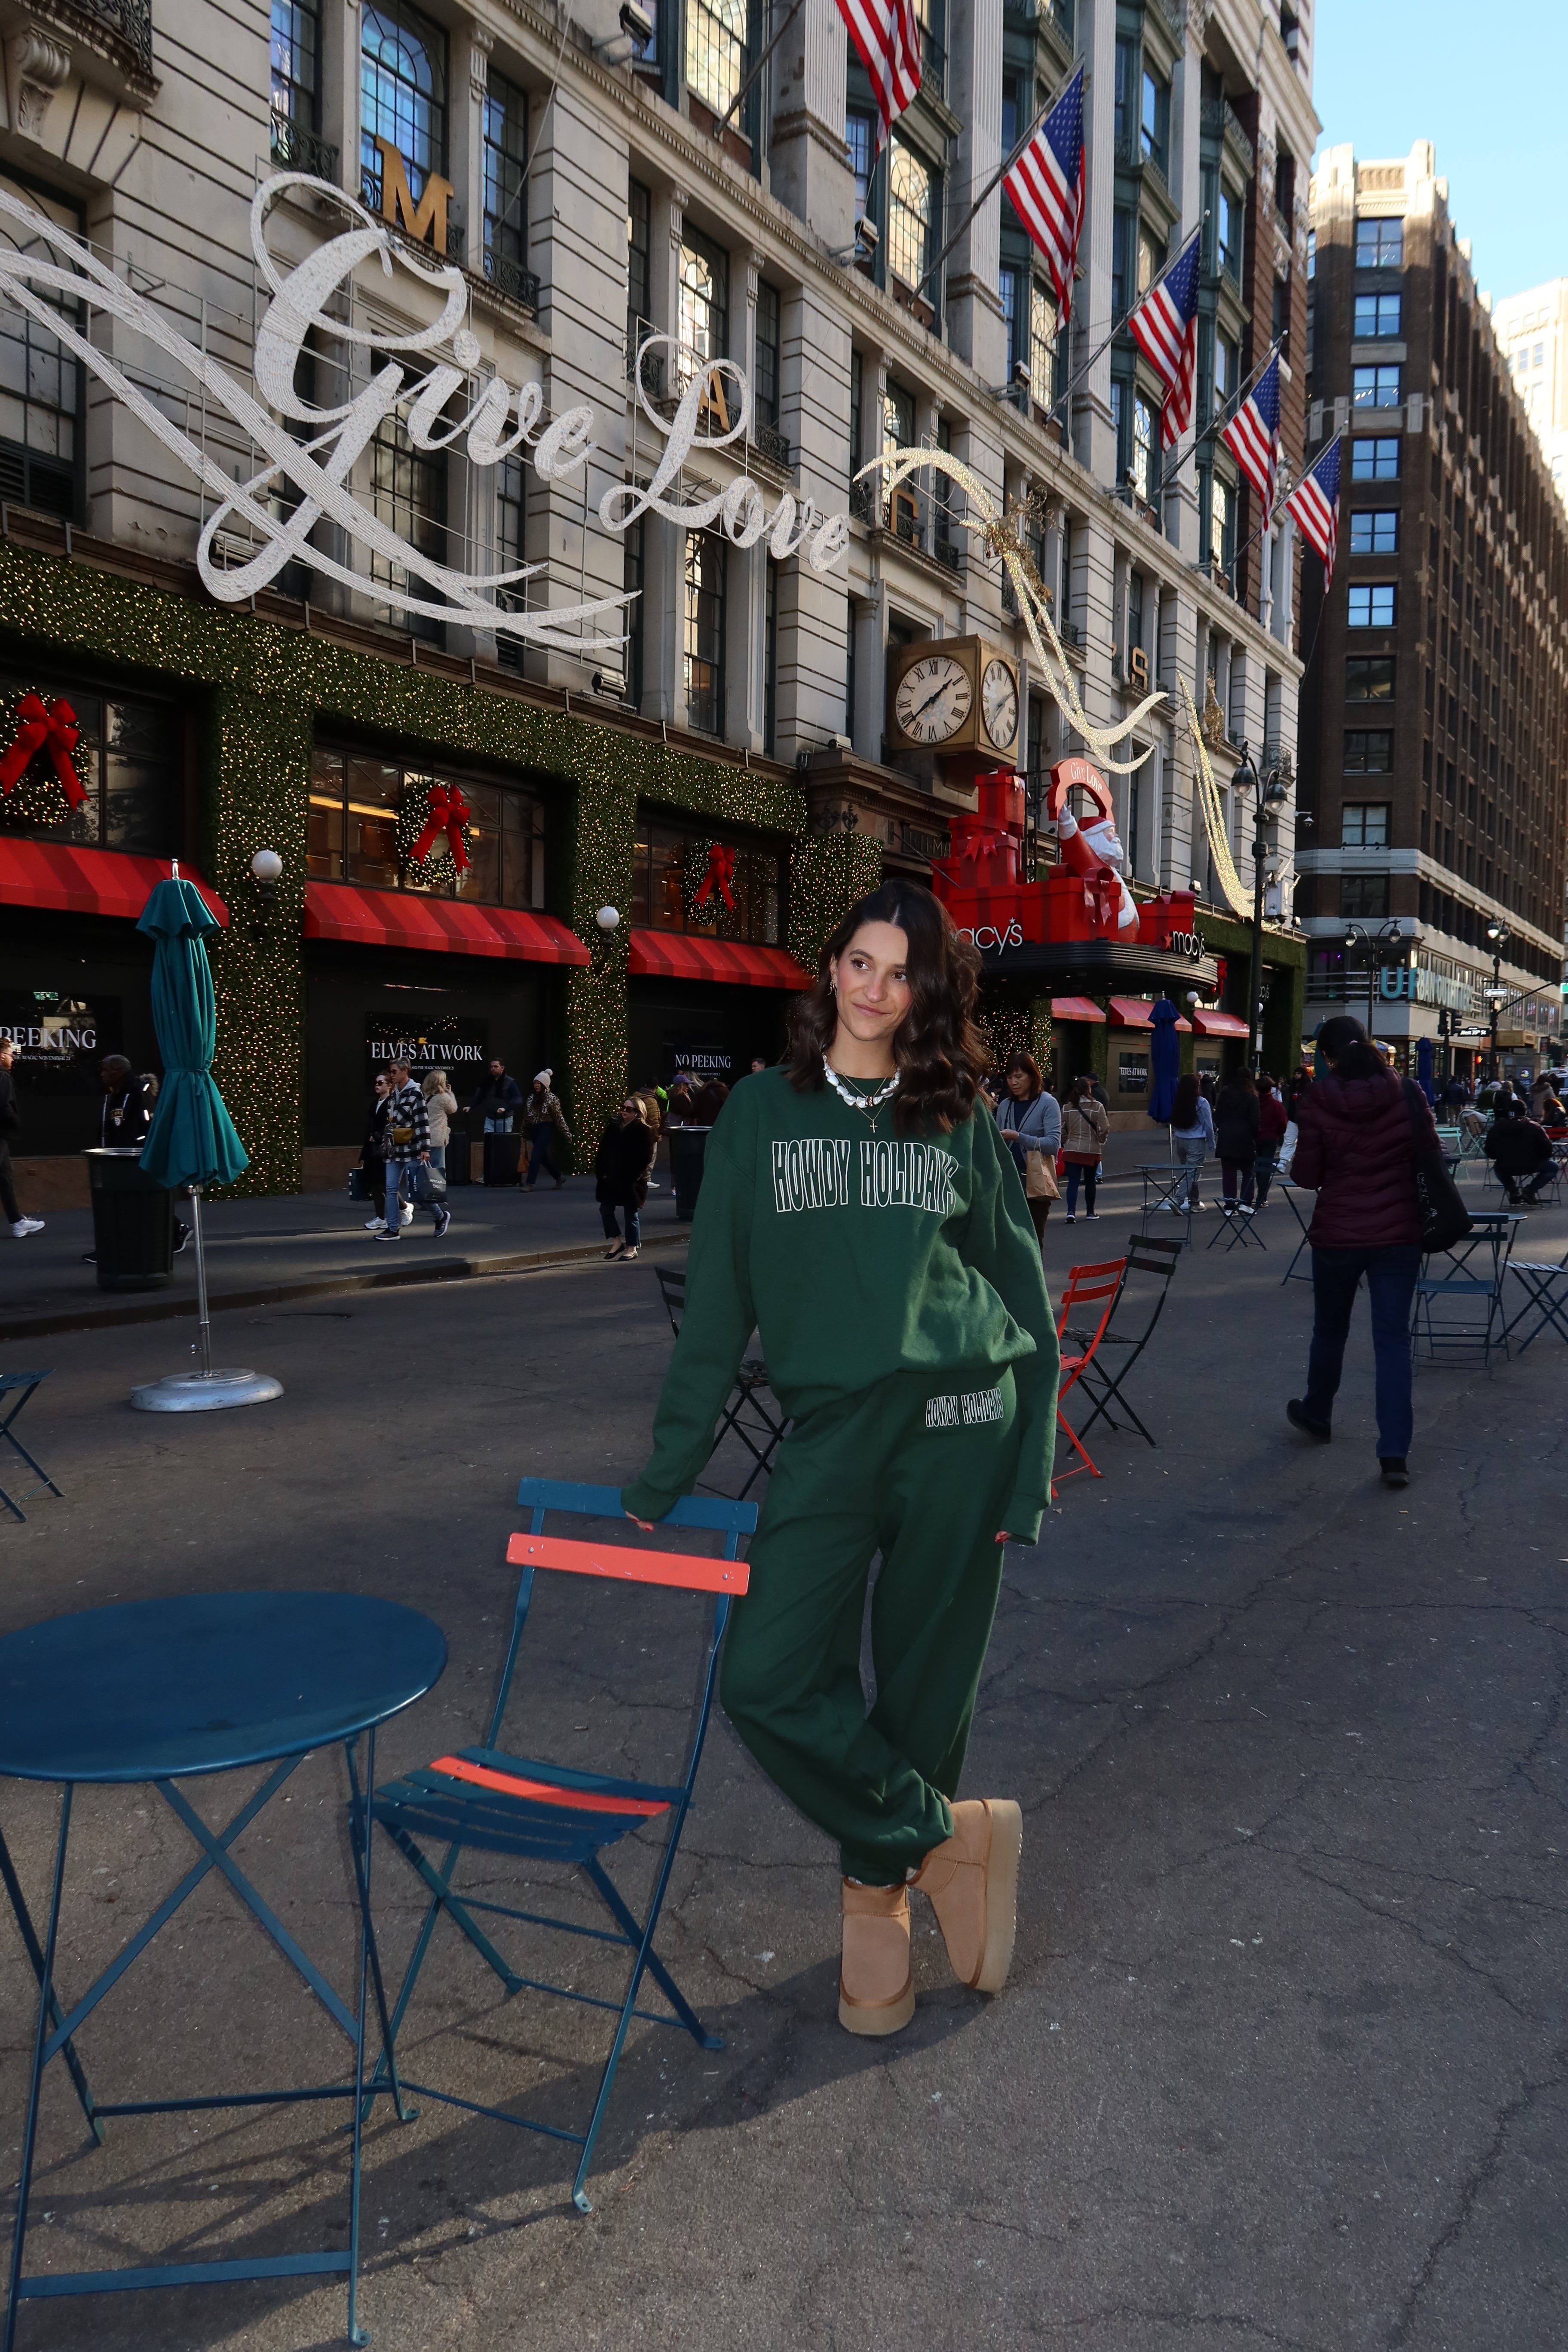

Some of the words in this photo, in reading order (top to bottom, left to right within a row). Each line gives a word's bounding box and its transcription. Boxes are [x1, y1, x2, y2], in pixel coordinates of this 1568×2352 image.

[374, 135, 453, 254] M
[196, 171, 598, 602] Give
[598, 334, 849, 573] Love
[1071, 762, 1086, 780] Give
[1087, 766, 1102, 793] Love
[372, 1042, 416, 1059] ELVES
[420, 1044, 438, 1060] AT
[440, 1044, 483, 1061] WORK
[675, 1054, 689, 1067] NO
[692, 1055, 731, 1068] PEEKING
[772, 1139, 850, 1213] HOWDY
[860, 1141, 959, 1219] HOLIDAYS
[926, 1396, 960, 1427] HOWDY
[961, 1387, 1004, 1424] HOLIDAYS
